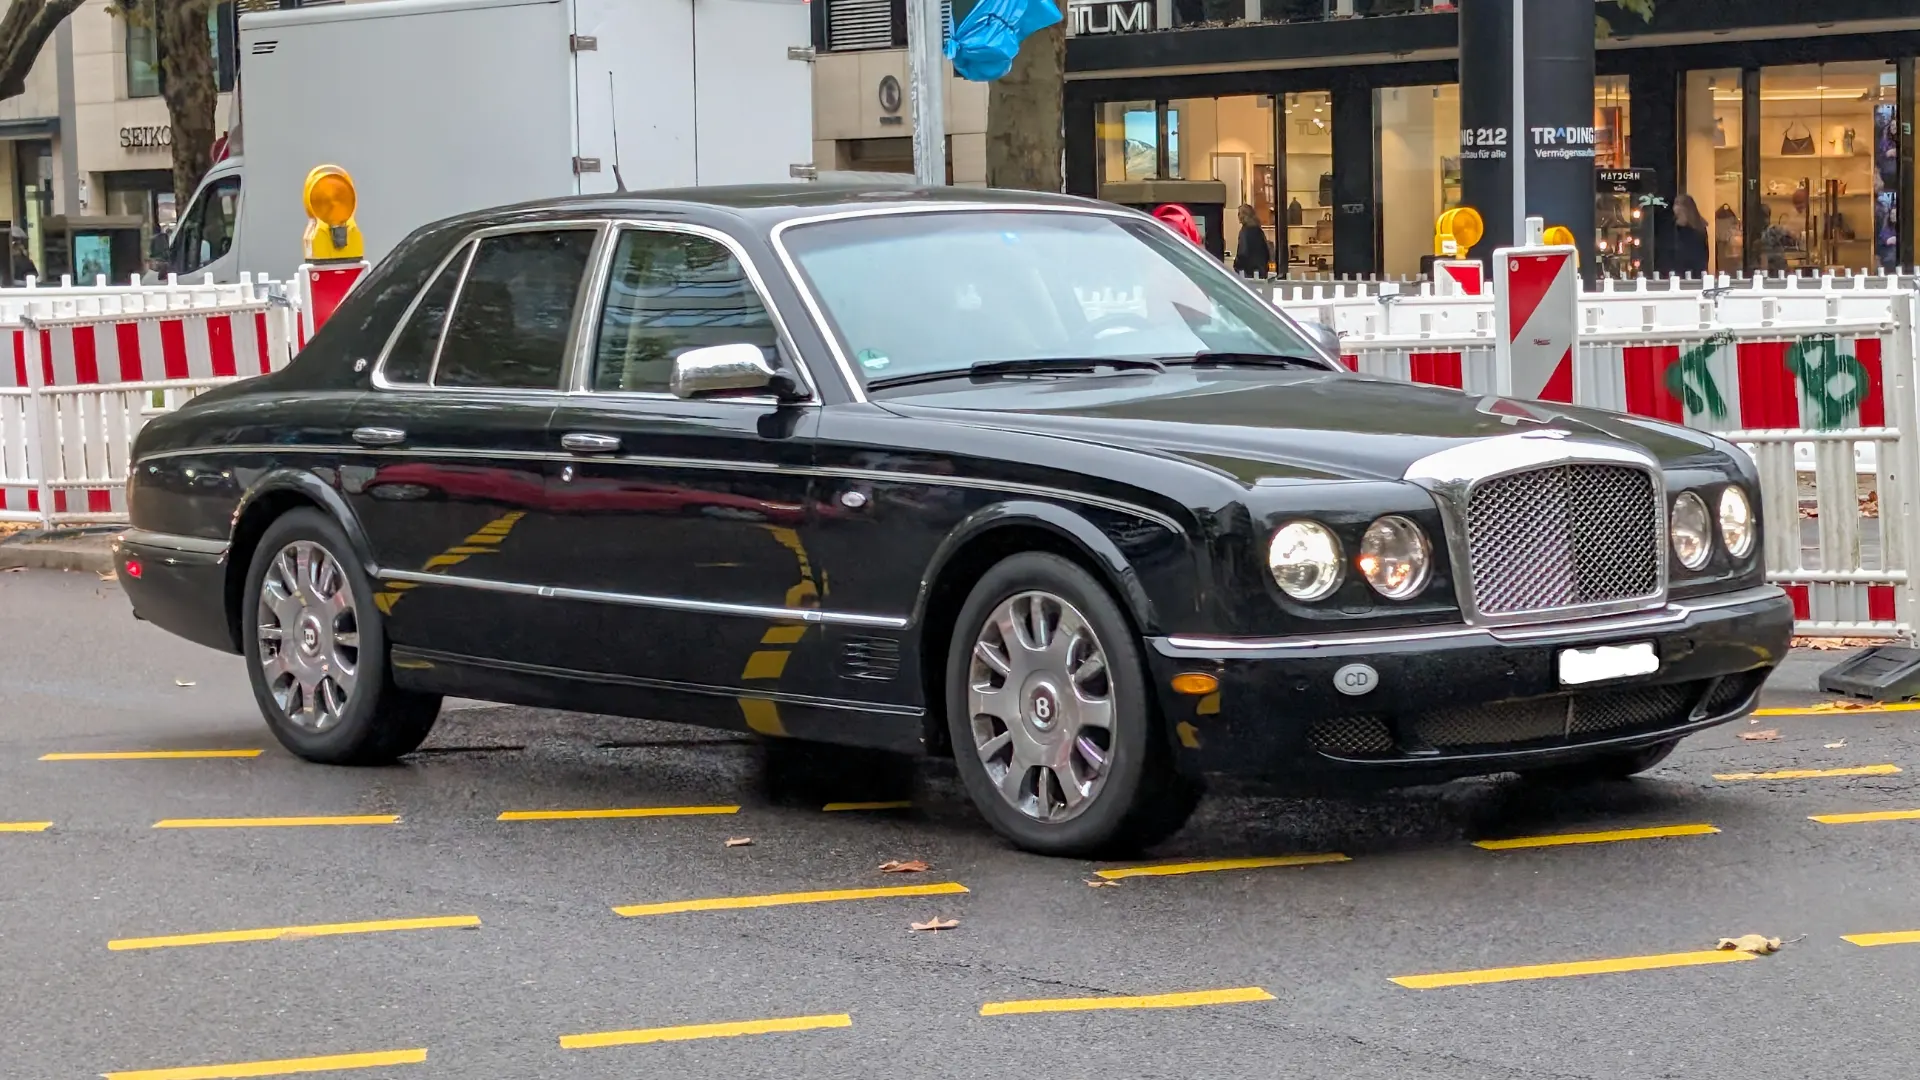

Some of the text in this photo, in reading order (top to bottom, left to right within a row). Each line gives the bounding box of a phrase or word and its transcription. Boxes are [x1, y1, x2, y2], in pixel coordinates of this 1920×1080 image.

[1069, 1, 1148, 35] TUMI
[120, 124, 172, 148] SEIKO
[1476, 127, 1507, 146] 212
[1344, 671, 1369, 687] CD
[1035, 696, 1051, 718] B
